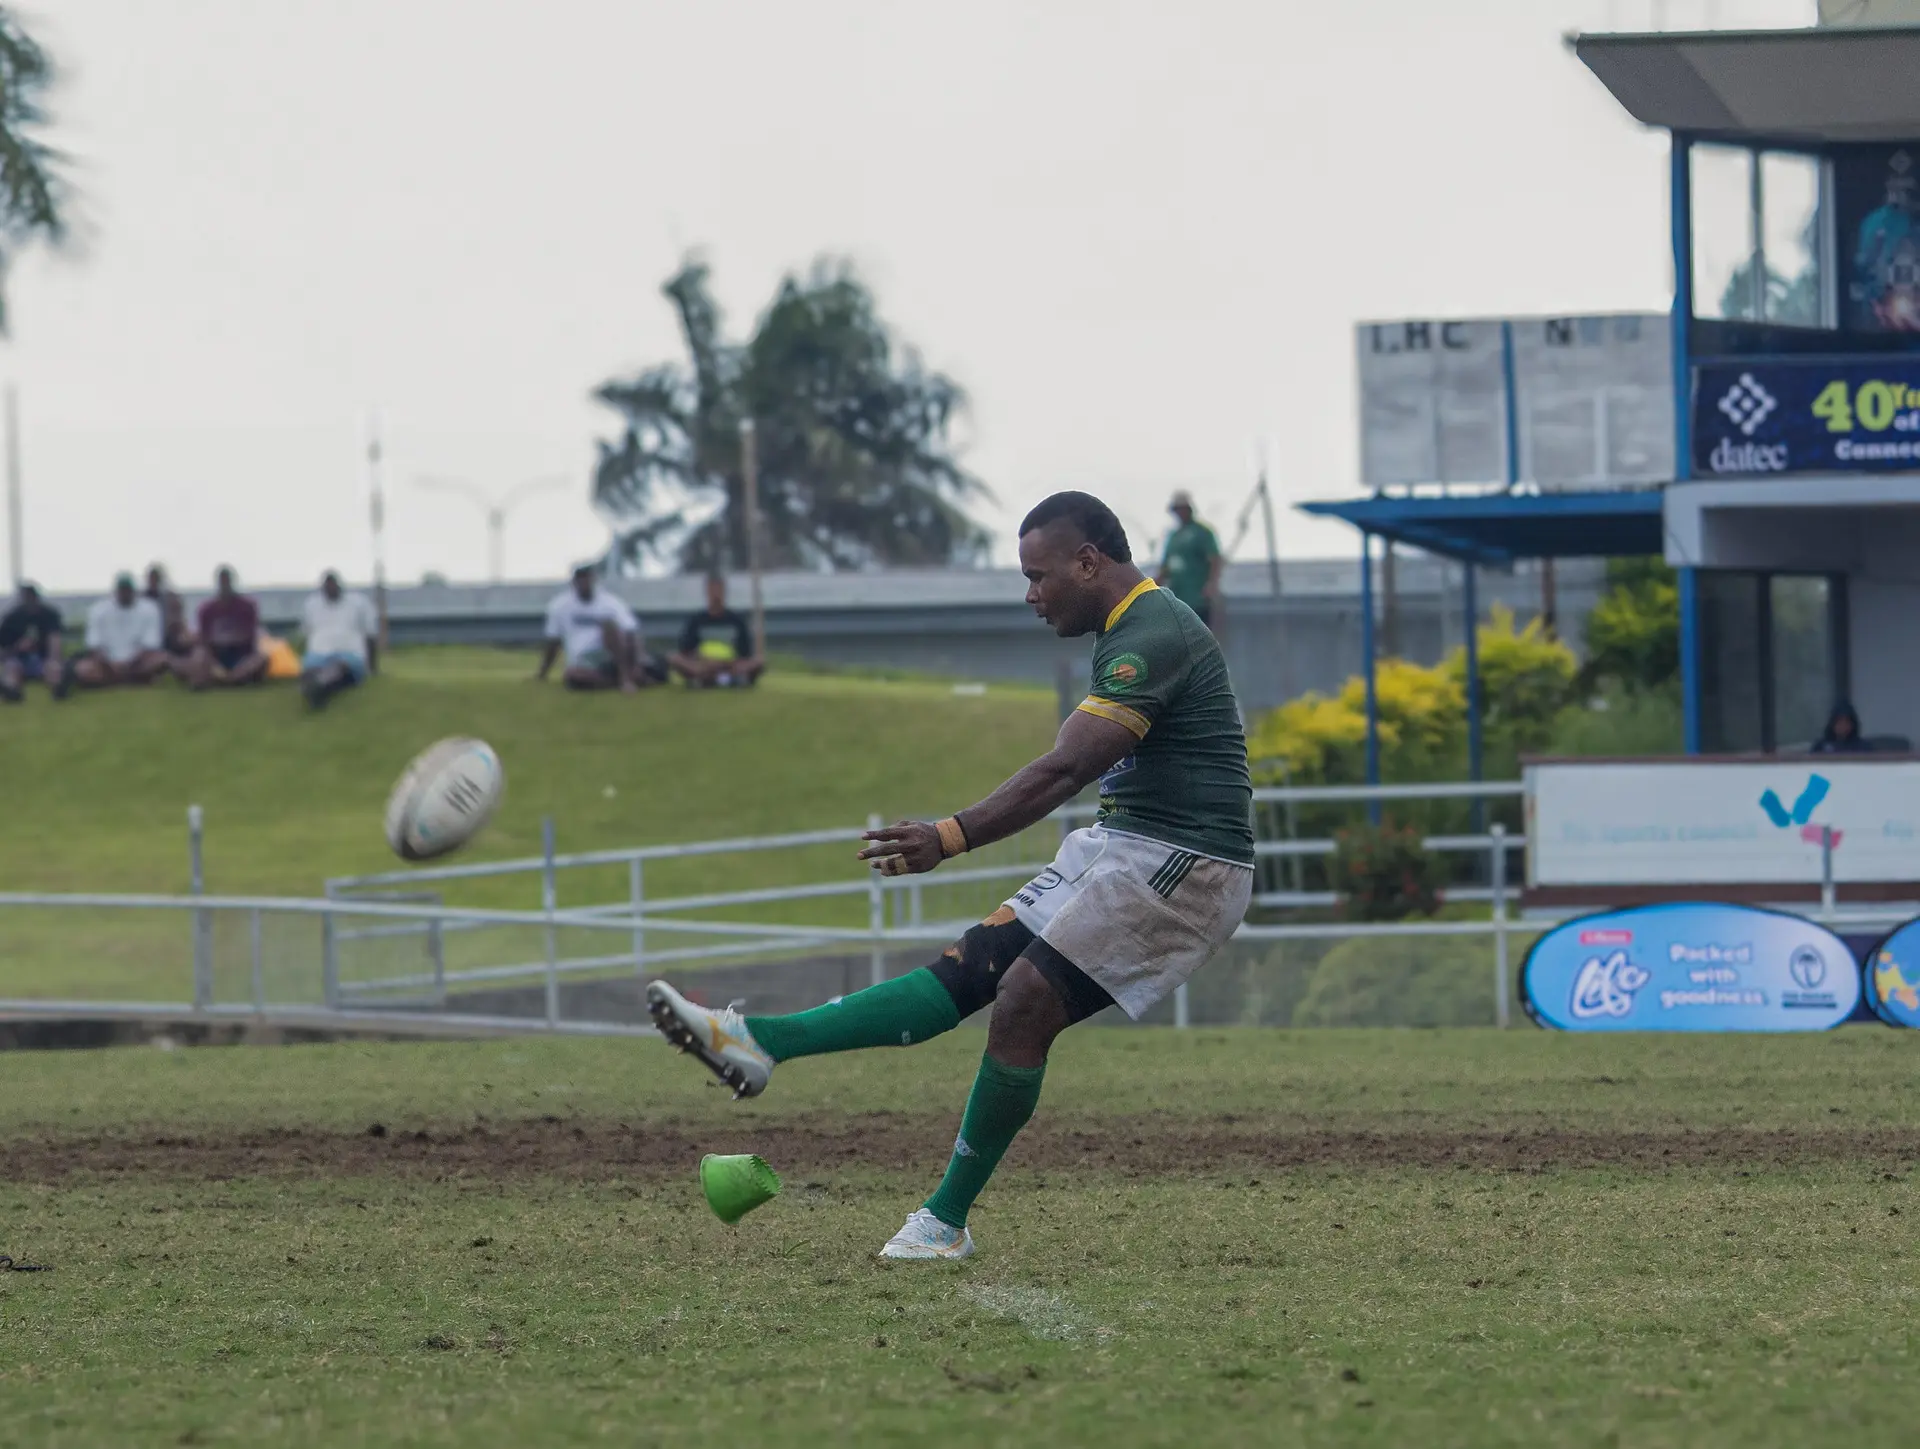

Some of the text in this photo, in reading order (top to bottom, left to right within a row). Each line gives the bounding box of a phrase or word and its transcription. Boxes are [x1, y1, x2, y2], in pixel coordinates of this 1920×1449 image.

[1811, 379, 1895, 433] 40
[1710, 437, 1788, 473] datec
[1670, 942, 1750, 962] Packed
[1689, 965, 1738, 983] with
